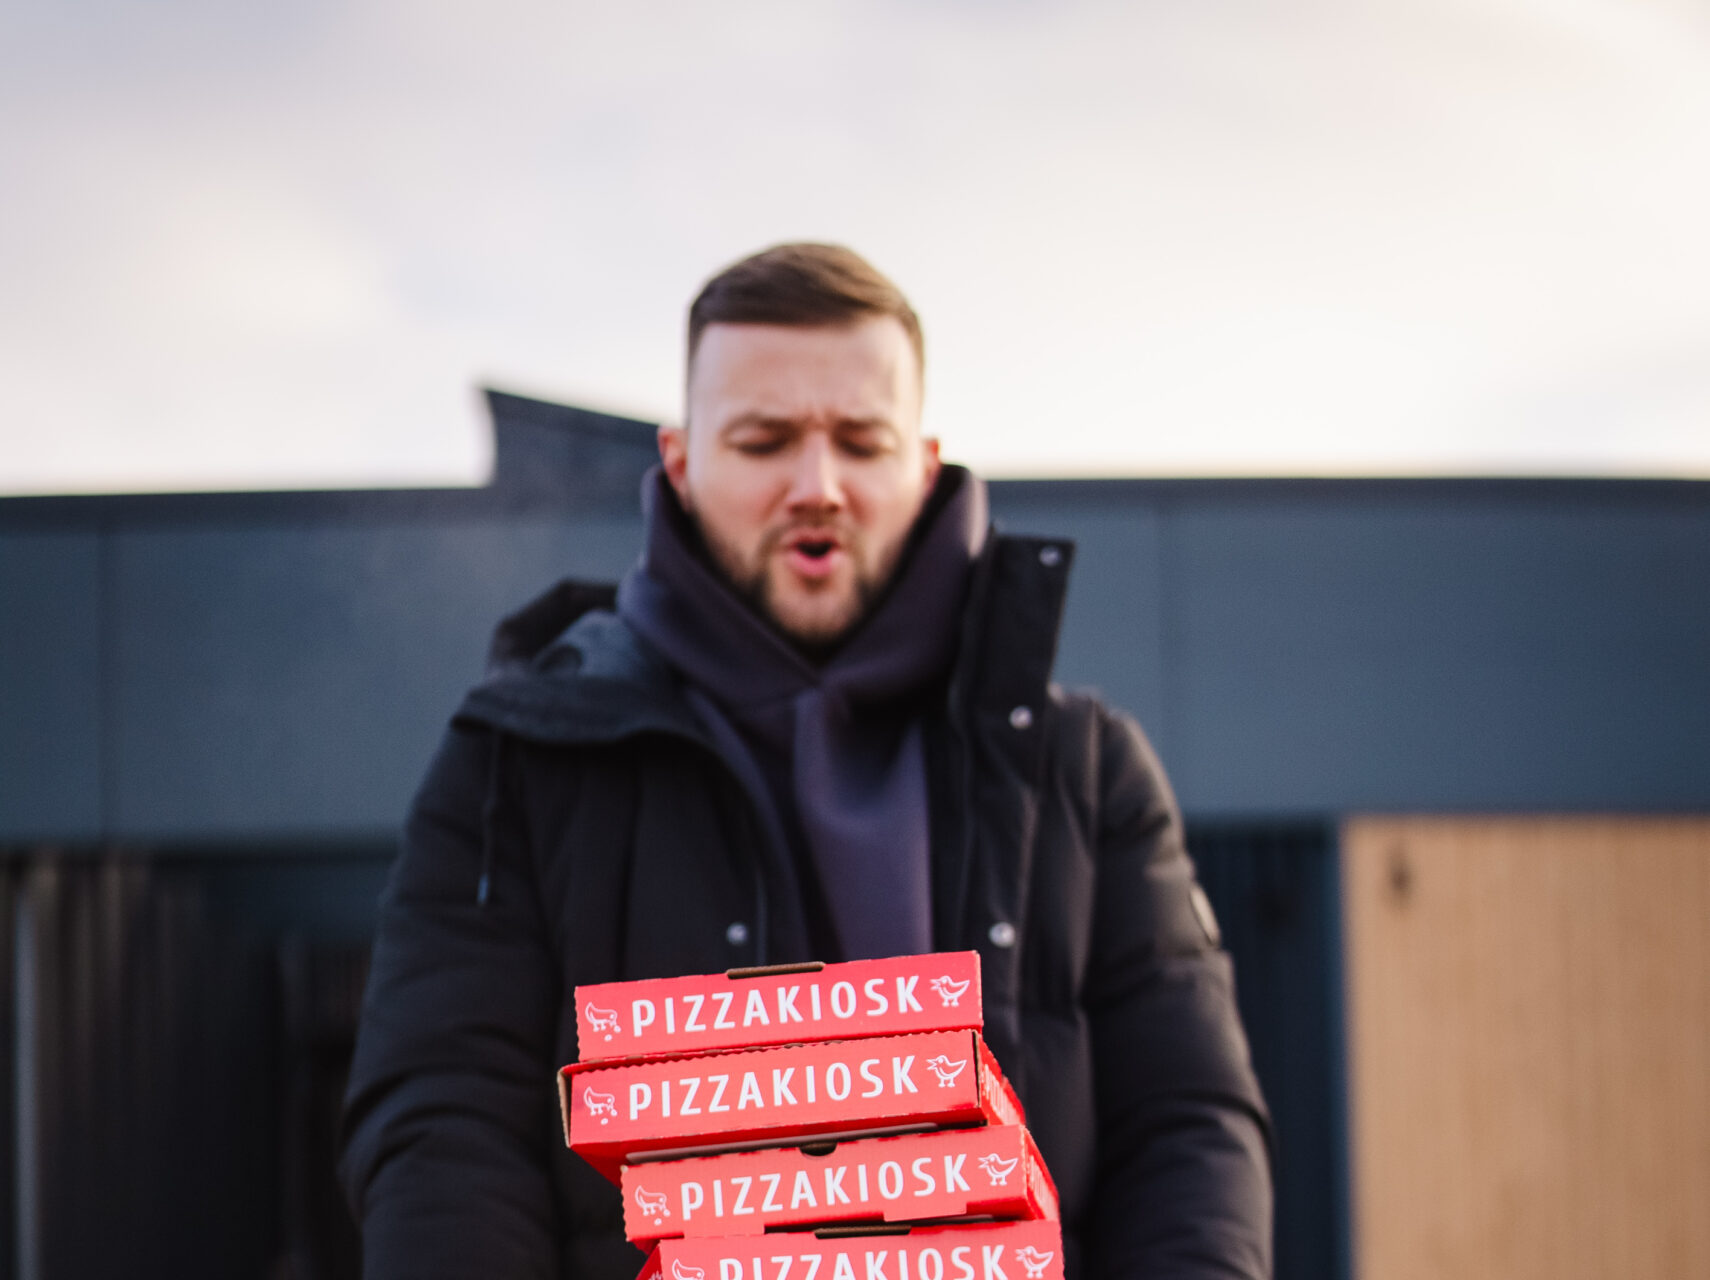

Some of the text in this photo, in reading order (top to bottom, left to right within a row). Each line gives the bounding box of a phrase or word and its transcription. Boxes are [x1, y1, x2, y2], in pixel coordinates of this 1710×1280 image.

[632, 975, 923, 1037] PIZZAKIOSK
[629, 1055, 919, 1121] PIZZAKIOSK
[680, 1153, 971, 1221] PIZZAKIOSK
